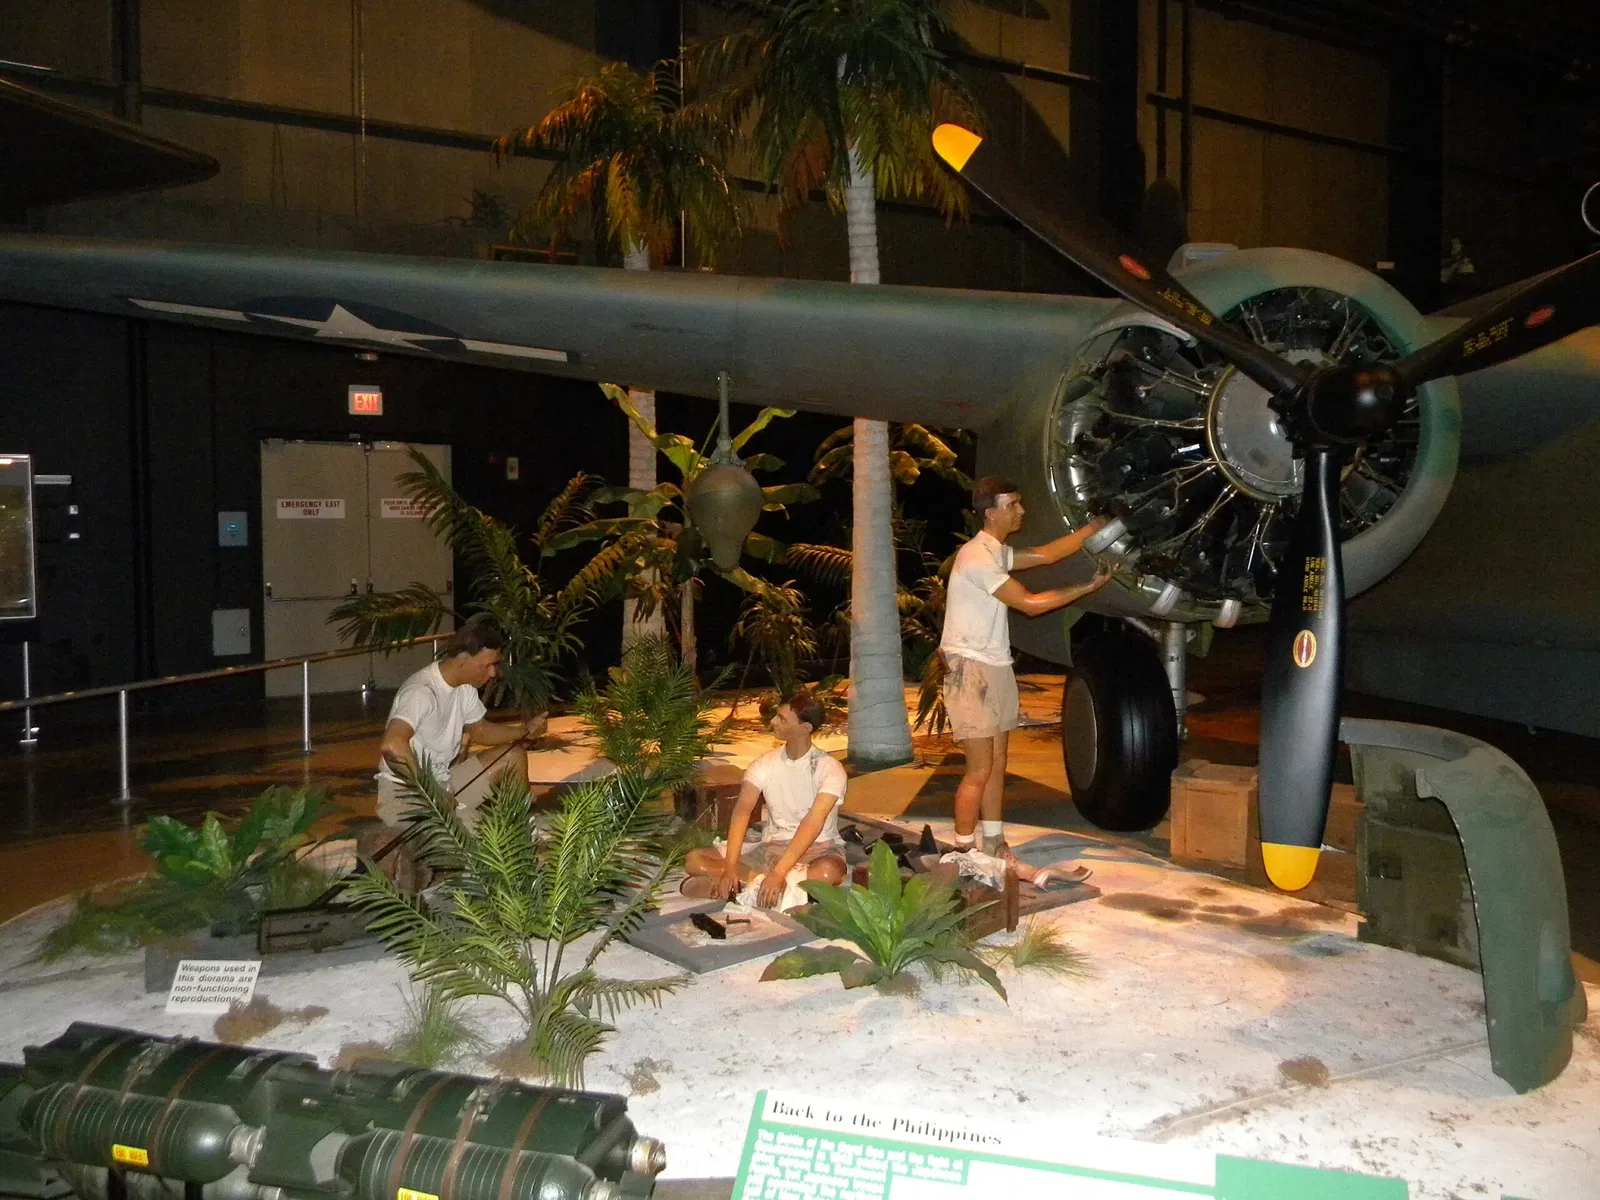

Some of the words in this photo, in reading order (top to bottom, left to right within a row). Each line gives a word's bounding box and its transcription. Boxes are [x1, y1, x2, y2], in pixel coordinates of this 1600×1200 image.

[354, 393, 379, 412] EXIT
[281, 500, 322, 508] EMERGENCY
[325, 500, 340, 508] EXIT
[303, 508, 320, 516] ONLY
[181, 963, 221, 973] Weapons
[224, 964, 245, 972] used
[248, 964, 257, 972] in
[178, 974, 195, 982] this
[198, 974, 235, 982] diorama
[238, 975, 254, 983] are
[174, 984, 250, 994] non-functioning
[772, 1100, 814, 1119] Back
[825, 1110, 843, 1123] to
[852, 1112, 882, 1128] the
[892, 1117, 1003, 1144] Philippines
